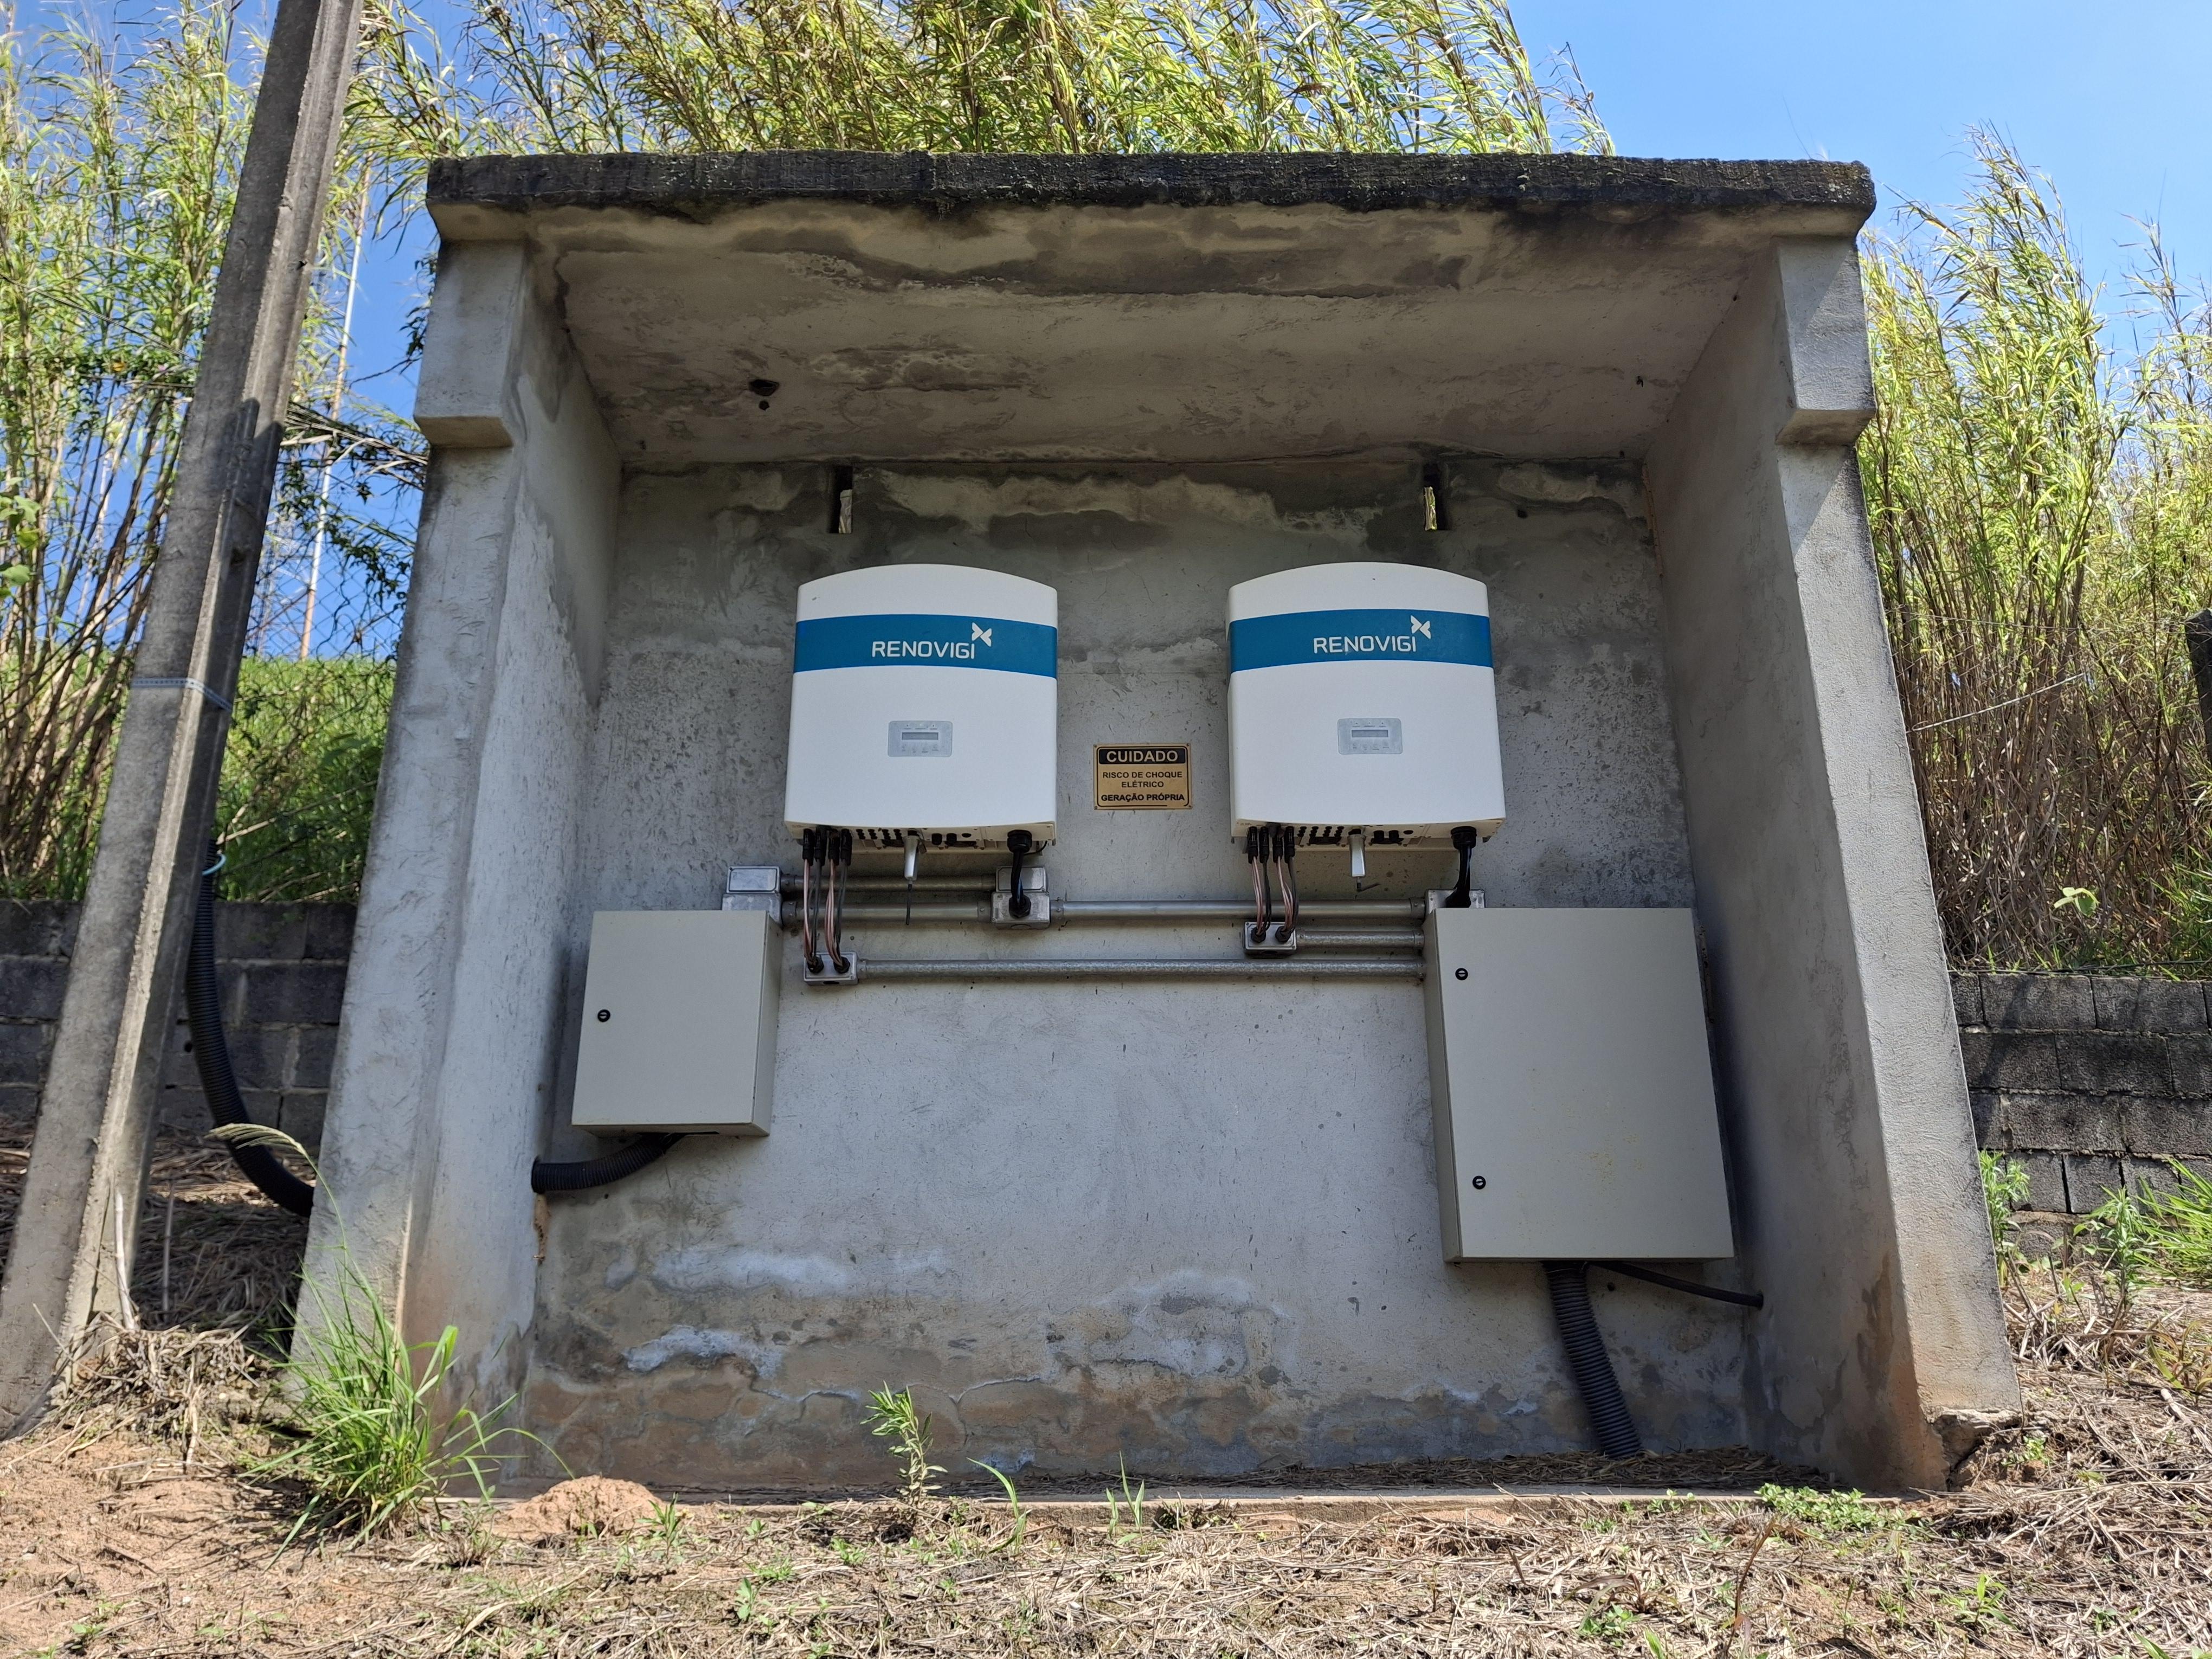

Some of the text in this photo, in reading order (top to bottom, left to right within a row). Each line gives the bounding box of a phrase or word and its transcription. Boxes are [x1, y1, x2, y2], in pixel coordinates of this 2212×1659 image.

[871, 640, 975, 659] RENOVIGI
[1314, 635, 1416, 654] RENOVIGI
[1106, 750, 1178, 762] CUIDADO
[1121, 780, 1164, 788] ELÉTRICO
[1101, 792, 1185, 802] GERAÇÃO PRÓPRIA
